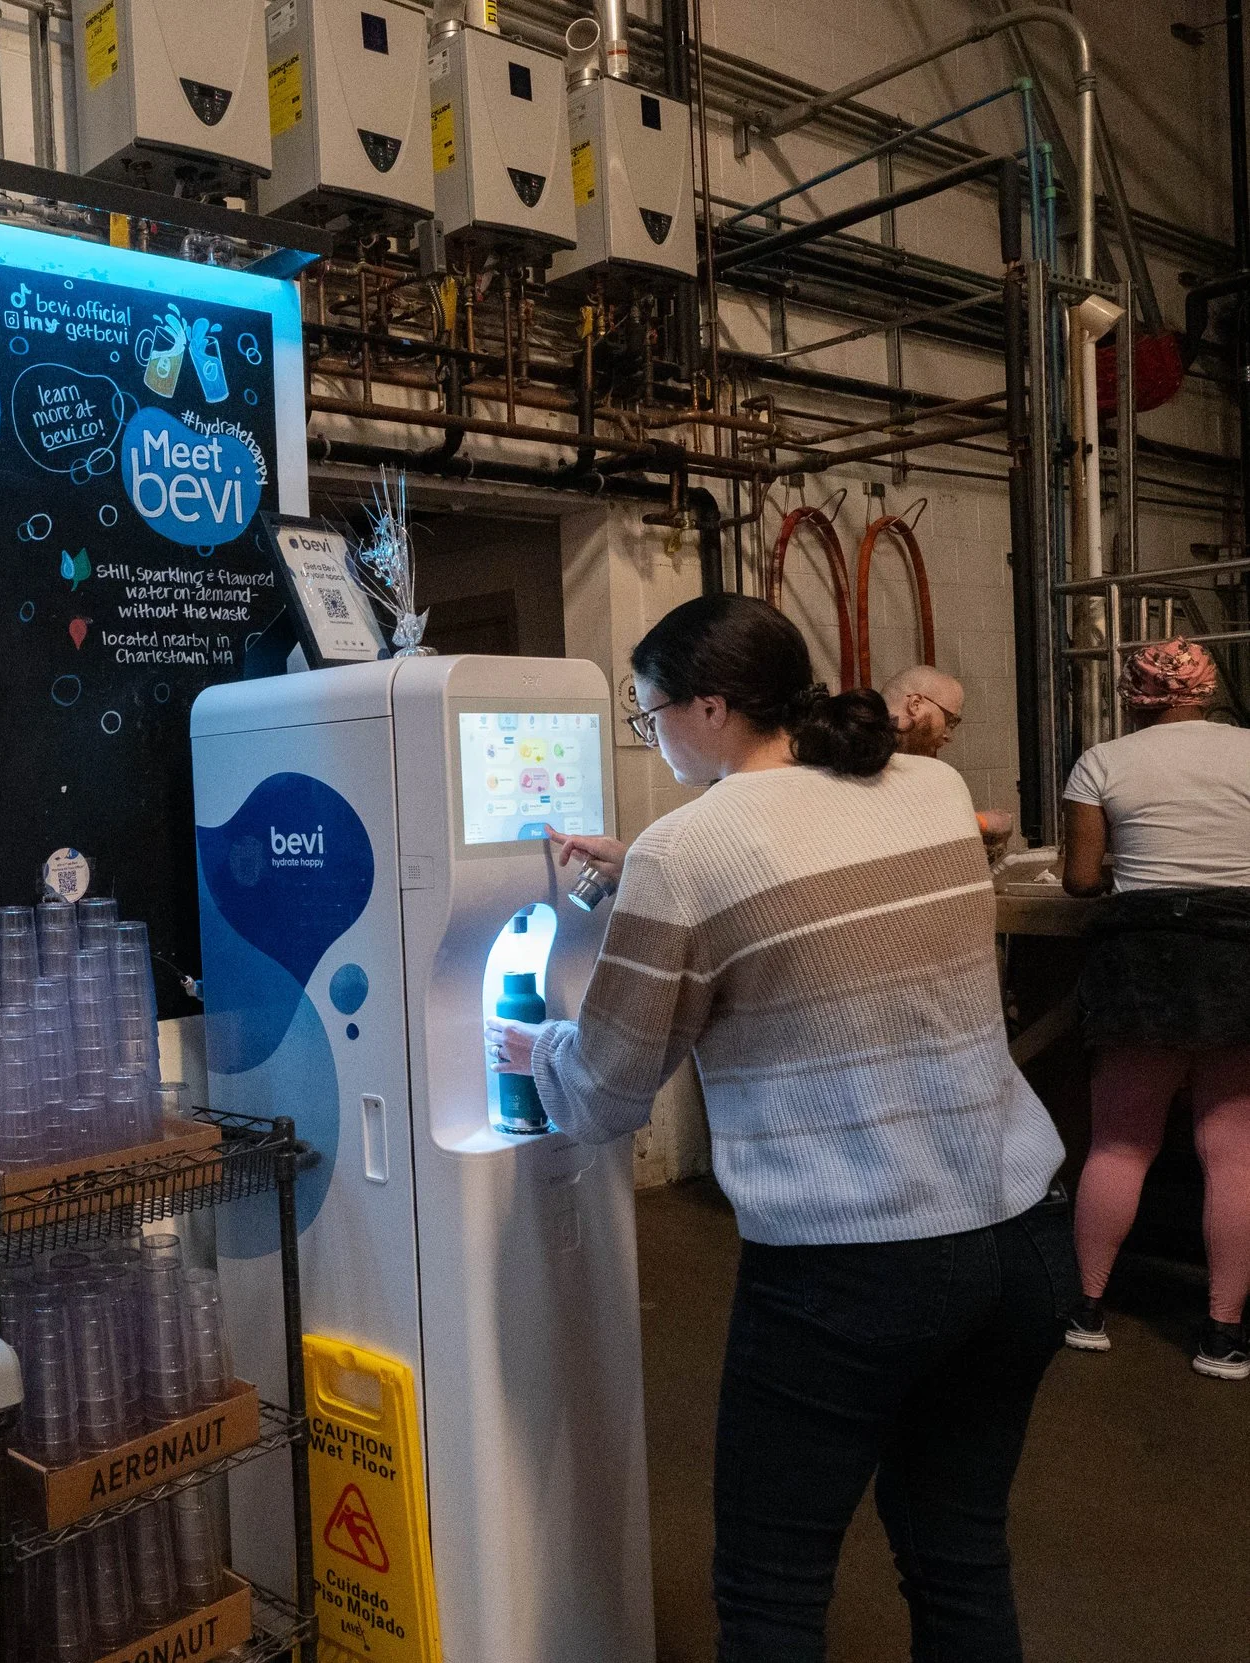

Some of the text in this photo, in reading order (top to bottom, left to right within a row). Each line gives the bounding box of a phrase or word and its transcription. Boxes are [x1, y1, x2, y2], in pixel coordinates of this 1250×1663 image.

[37, 293, 131, 326] bevi.official
[66, 323, 128, 345] getbevi
[38, 385, 80, 406] learn
[32, 399, 97, 428] more at
[41, 419, 106, 448] bevi.co!
[143, 430, 222, 473] Meet
[131, 448, 243, 524] bevi
[299, 535, 332, 552] bevi
[126, 585, 172, 600] water
[216, 569, 274, 587] flavored
[118, 604, 250, 621] without the waste
[101, 631, 230, 652] located nearby in
[212, 651, 233, 664] MA
[270, 824, 324, 855] bevi
[272, 858, 324, 868] hydrate happy
[313, 1418, 393, 1462] CAUTION
[89, 1416, 226, 1501] AERONAUT
[310, 1432, 397, 1482] Wet Floor
[326, 1568, 389, 1613] Cuidado
[313, 1578, 405, 1640] Piso Mojado
